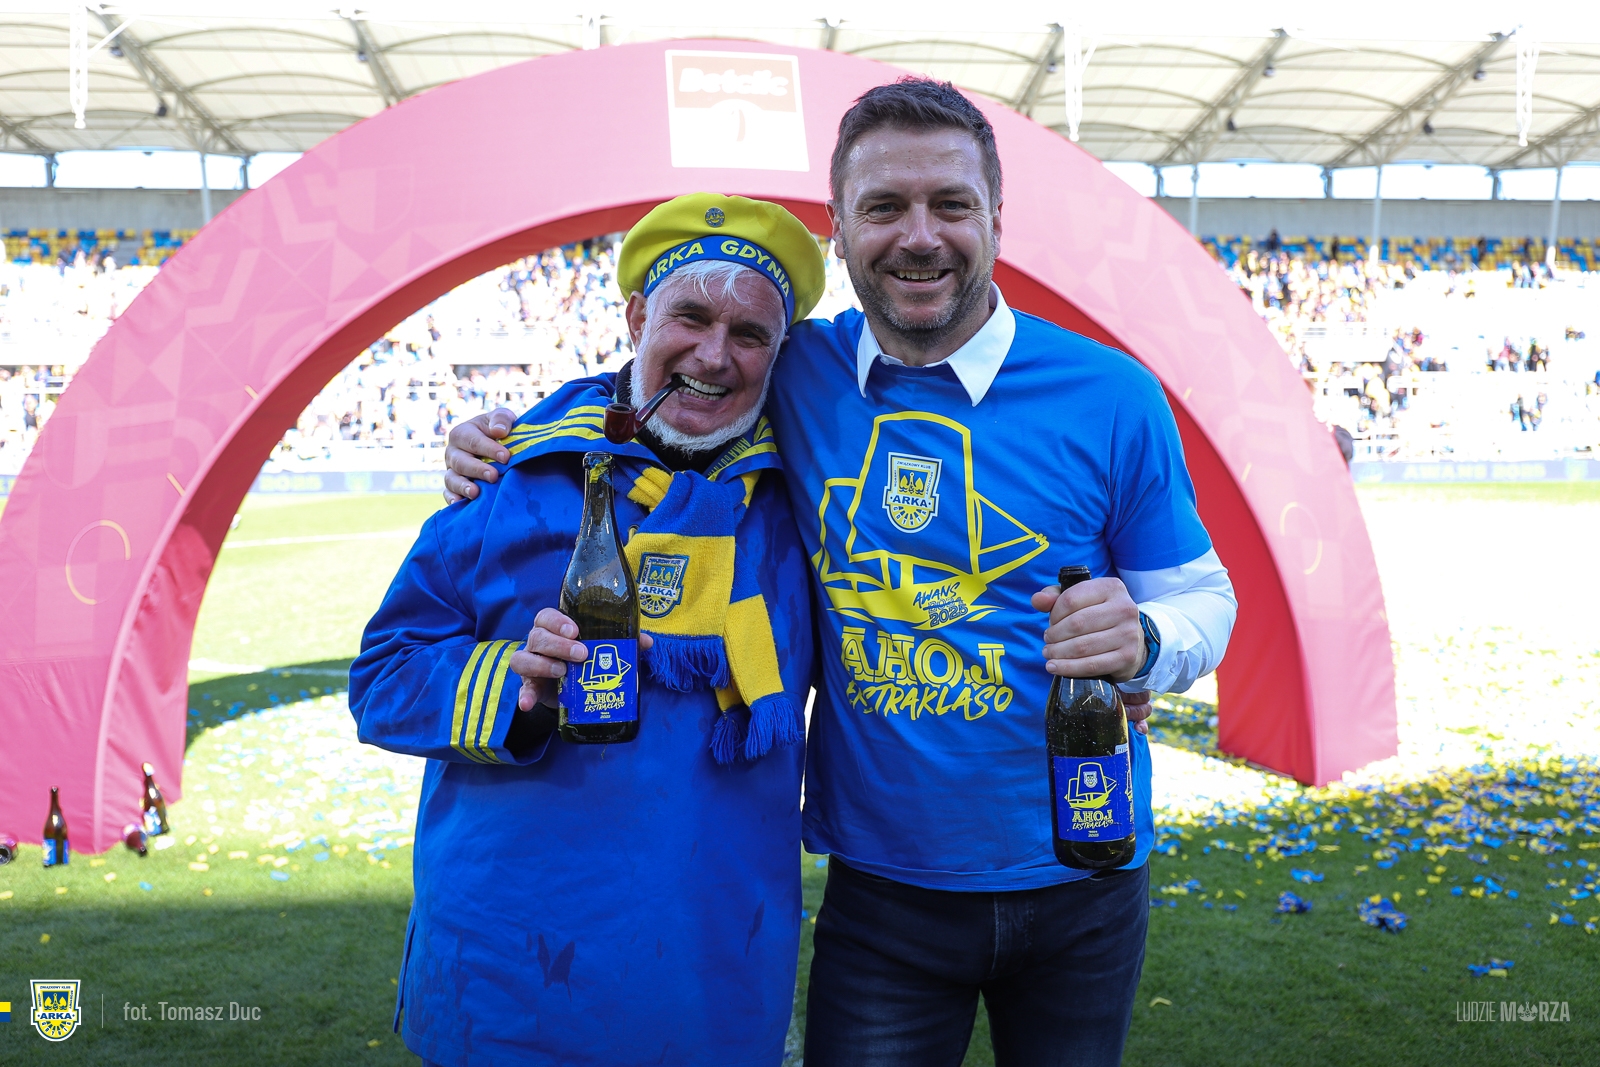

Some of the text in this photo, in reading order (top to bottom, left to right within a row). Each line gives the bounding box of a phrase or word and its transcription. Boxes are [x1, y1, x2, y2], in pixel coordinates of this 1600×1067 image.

[647, 240, 790, 298] ARKA GDYNIA
[391, 470, 446, 490] AHO
[892, 494, 928, 508] ARKA
[641, 586, 674, 598] ARKA
[912, 581, 961, 609] AWANS
[929, 604, 969, 628] 2025
[841, 625, 1006, 690] AHOJ
[584, 692, 625, 705] AHOJ
[1071, 809, 1113, 823] AHOJ
